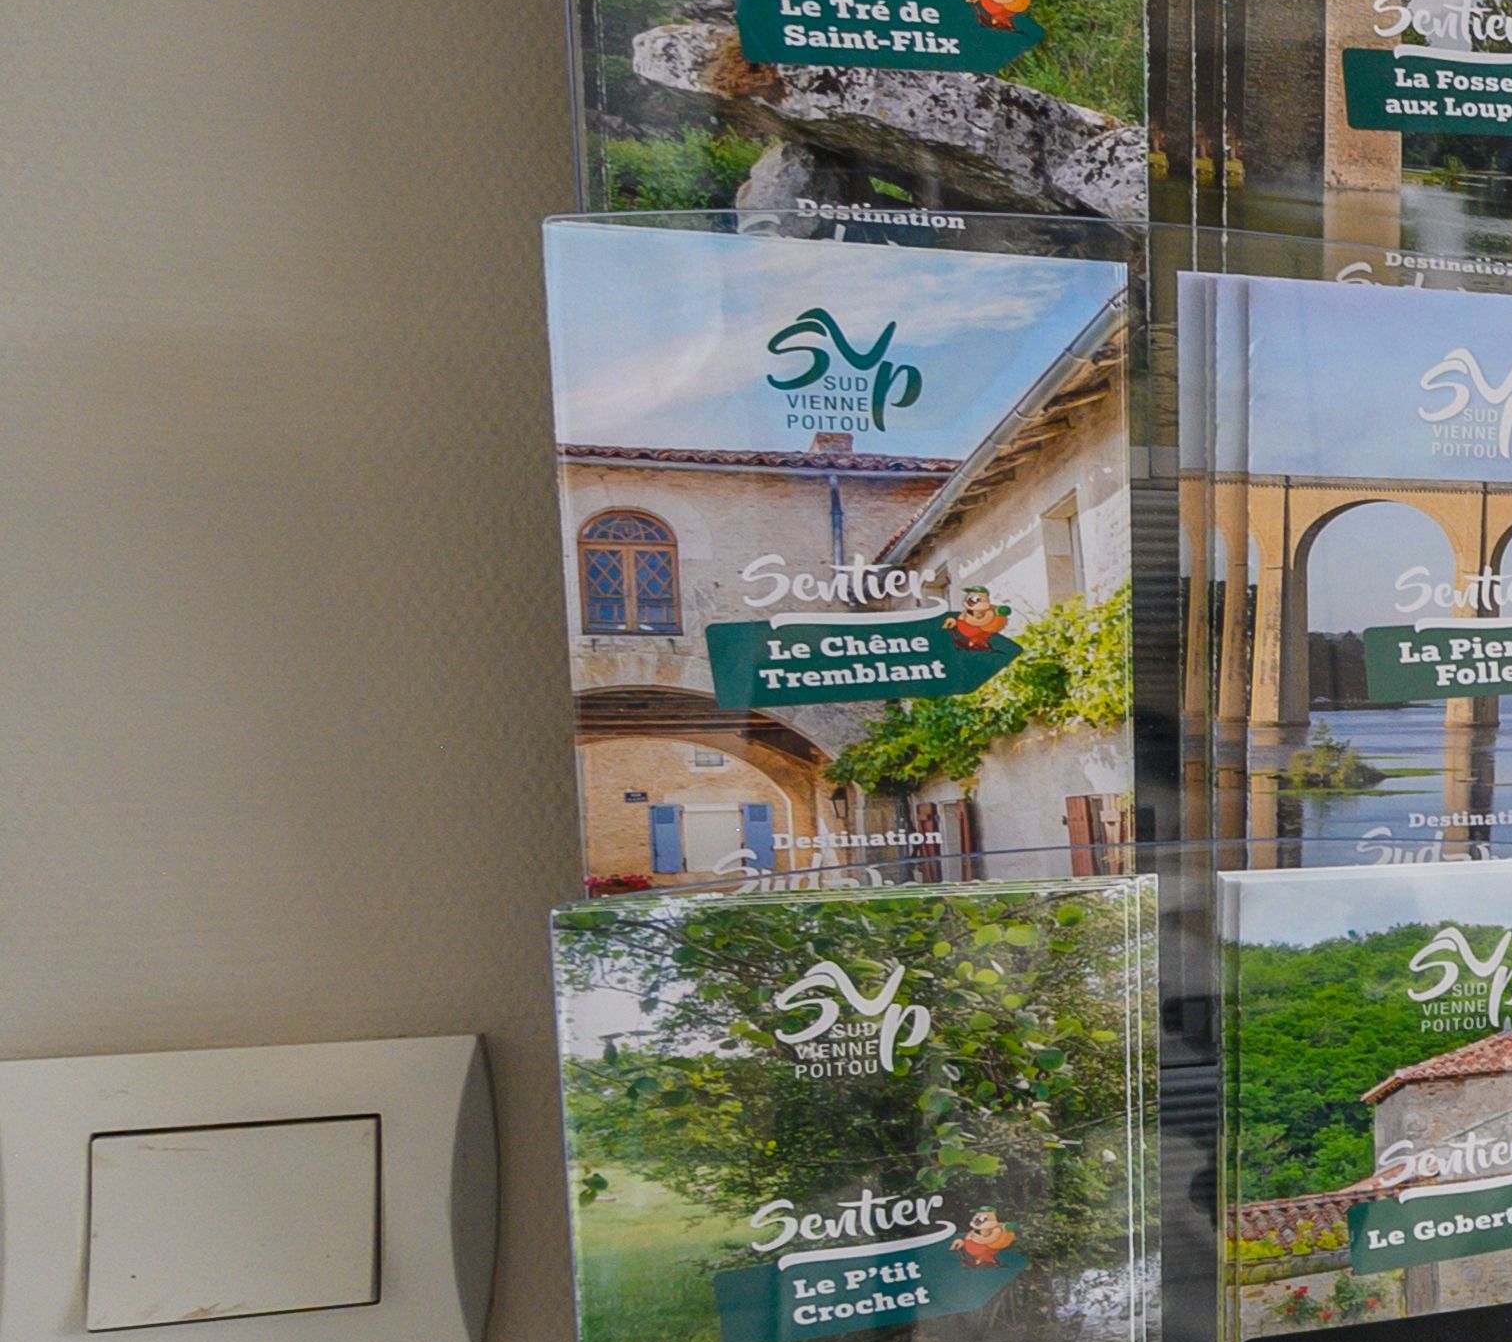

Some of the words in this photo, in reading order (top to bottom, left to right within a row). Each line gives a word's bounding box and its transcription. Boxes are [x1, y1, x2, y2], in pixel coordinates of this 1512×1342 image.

[899, 0, 939, 25] de
[784, 24, 960, 54] Saint-Flix
[1395, 69, 1430, 90] La
[1385, 97, 1437, 117] aux
[796, 197, 966, 230] Destination
[742, 554, 935, 608] Sentier
[767, 638, 811, 662] Le
[820, 631, 929, 658] Chêne
[1399, 641, 1442, 664] La
[759, 659, 946, 690] Tremblant
[773, 829, 943, 851] Destination
[750, 1189, 943, 1252] Sentier
[1367, 1227, 1405, 1250] Le
[793, 1278, 836, 1299] Le
[844, 1261, 921, 1290] P'tit
[793, 1287, 930, 1325] Crochet
